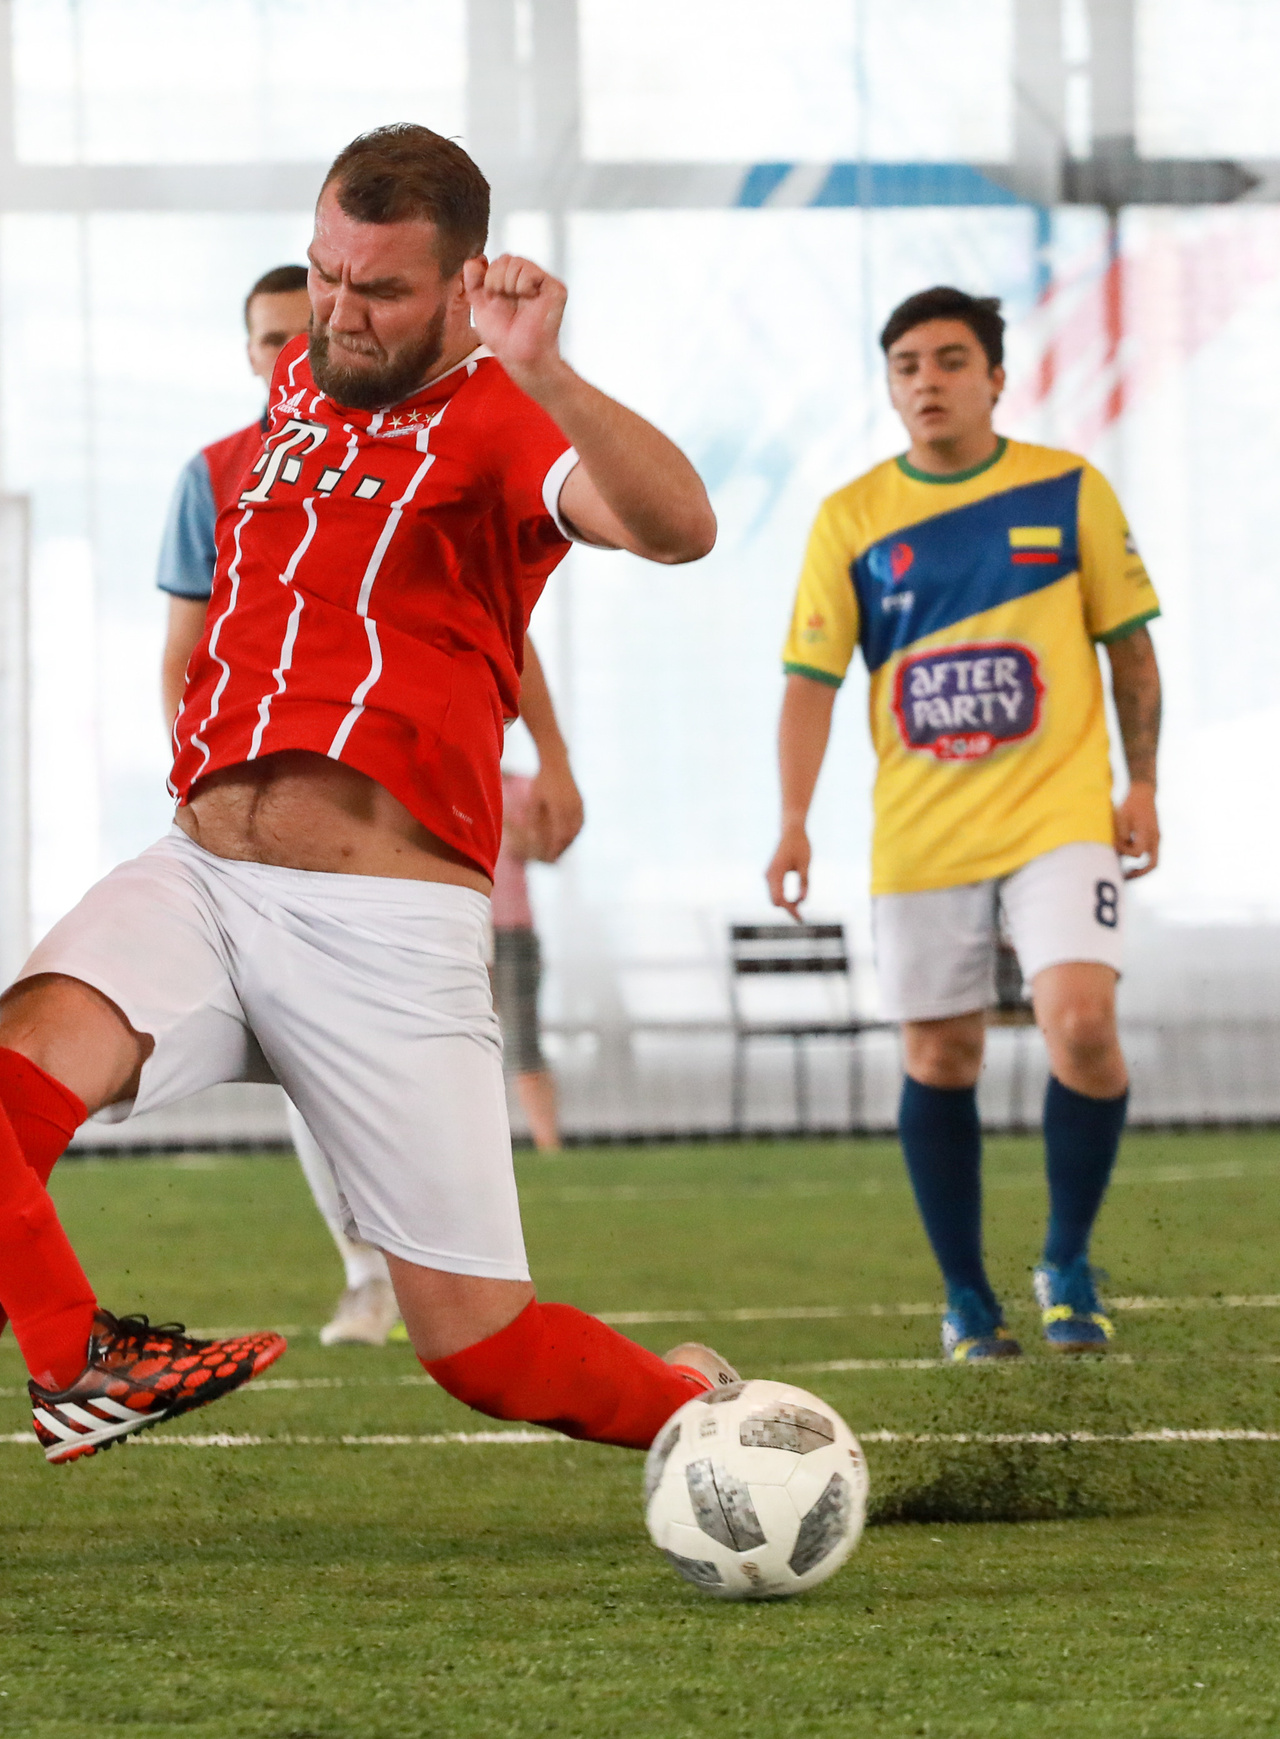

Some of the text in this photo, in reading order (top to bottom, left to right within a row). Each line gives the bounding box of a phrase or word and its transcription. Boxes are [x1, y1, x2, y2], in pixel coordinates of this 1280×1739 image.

[910, 656, 1019, 698] AFTER
[913, 689, 1023, 729] PARTY
[1095, 881, 1118, 929] 8
